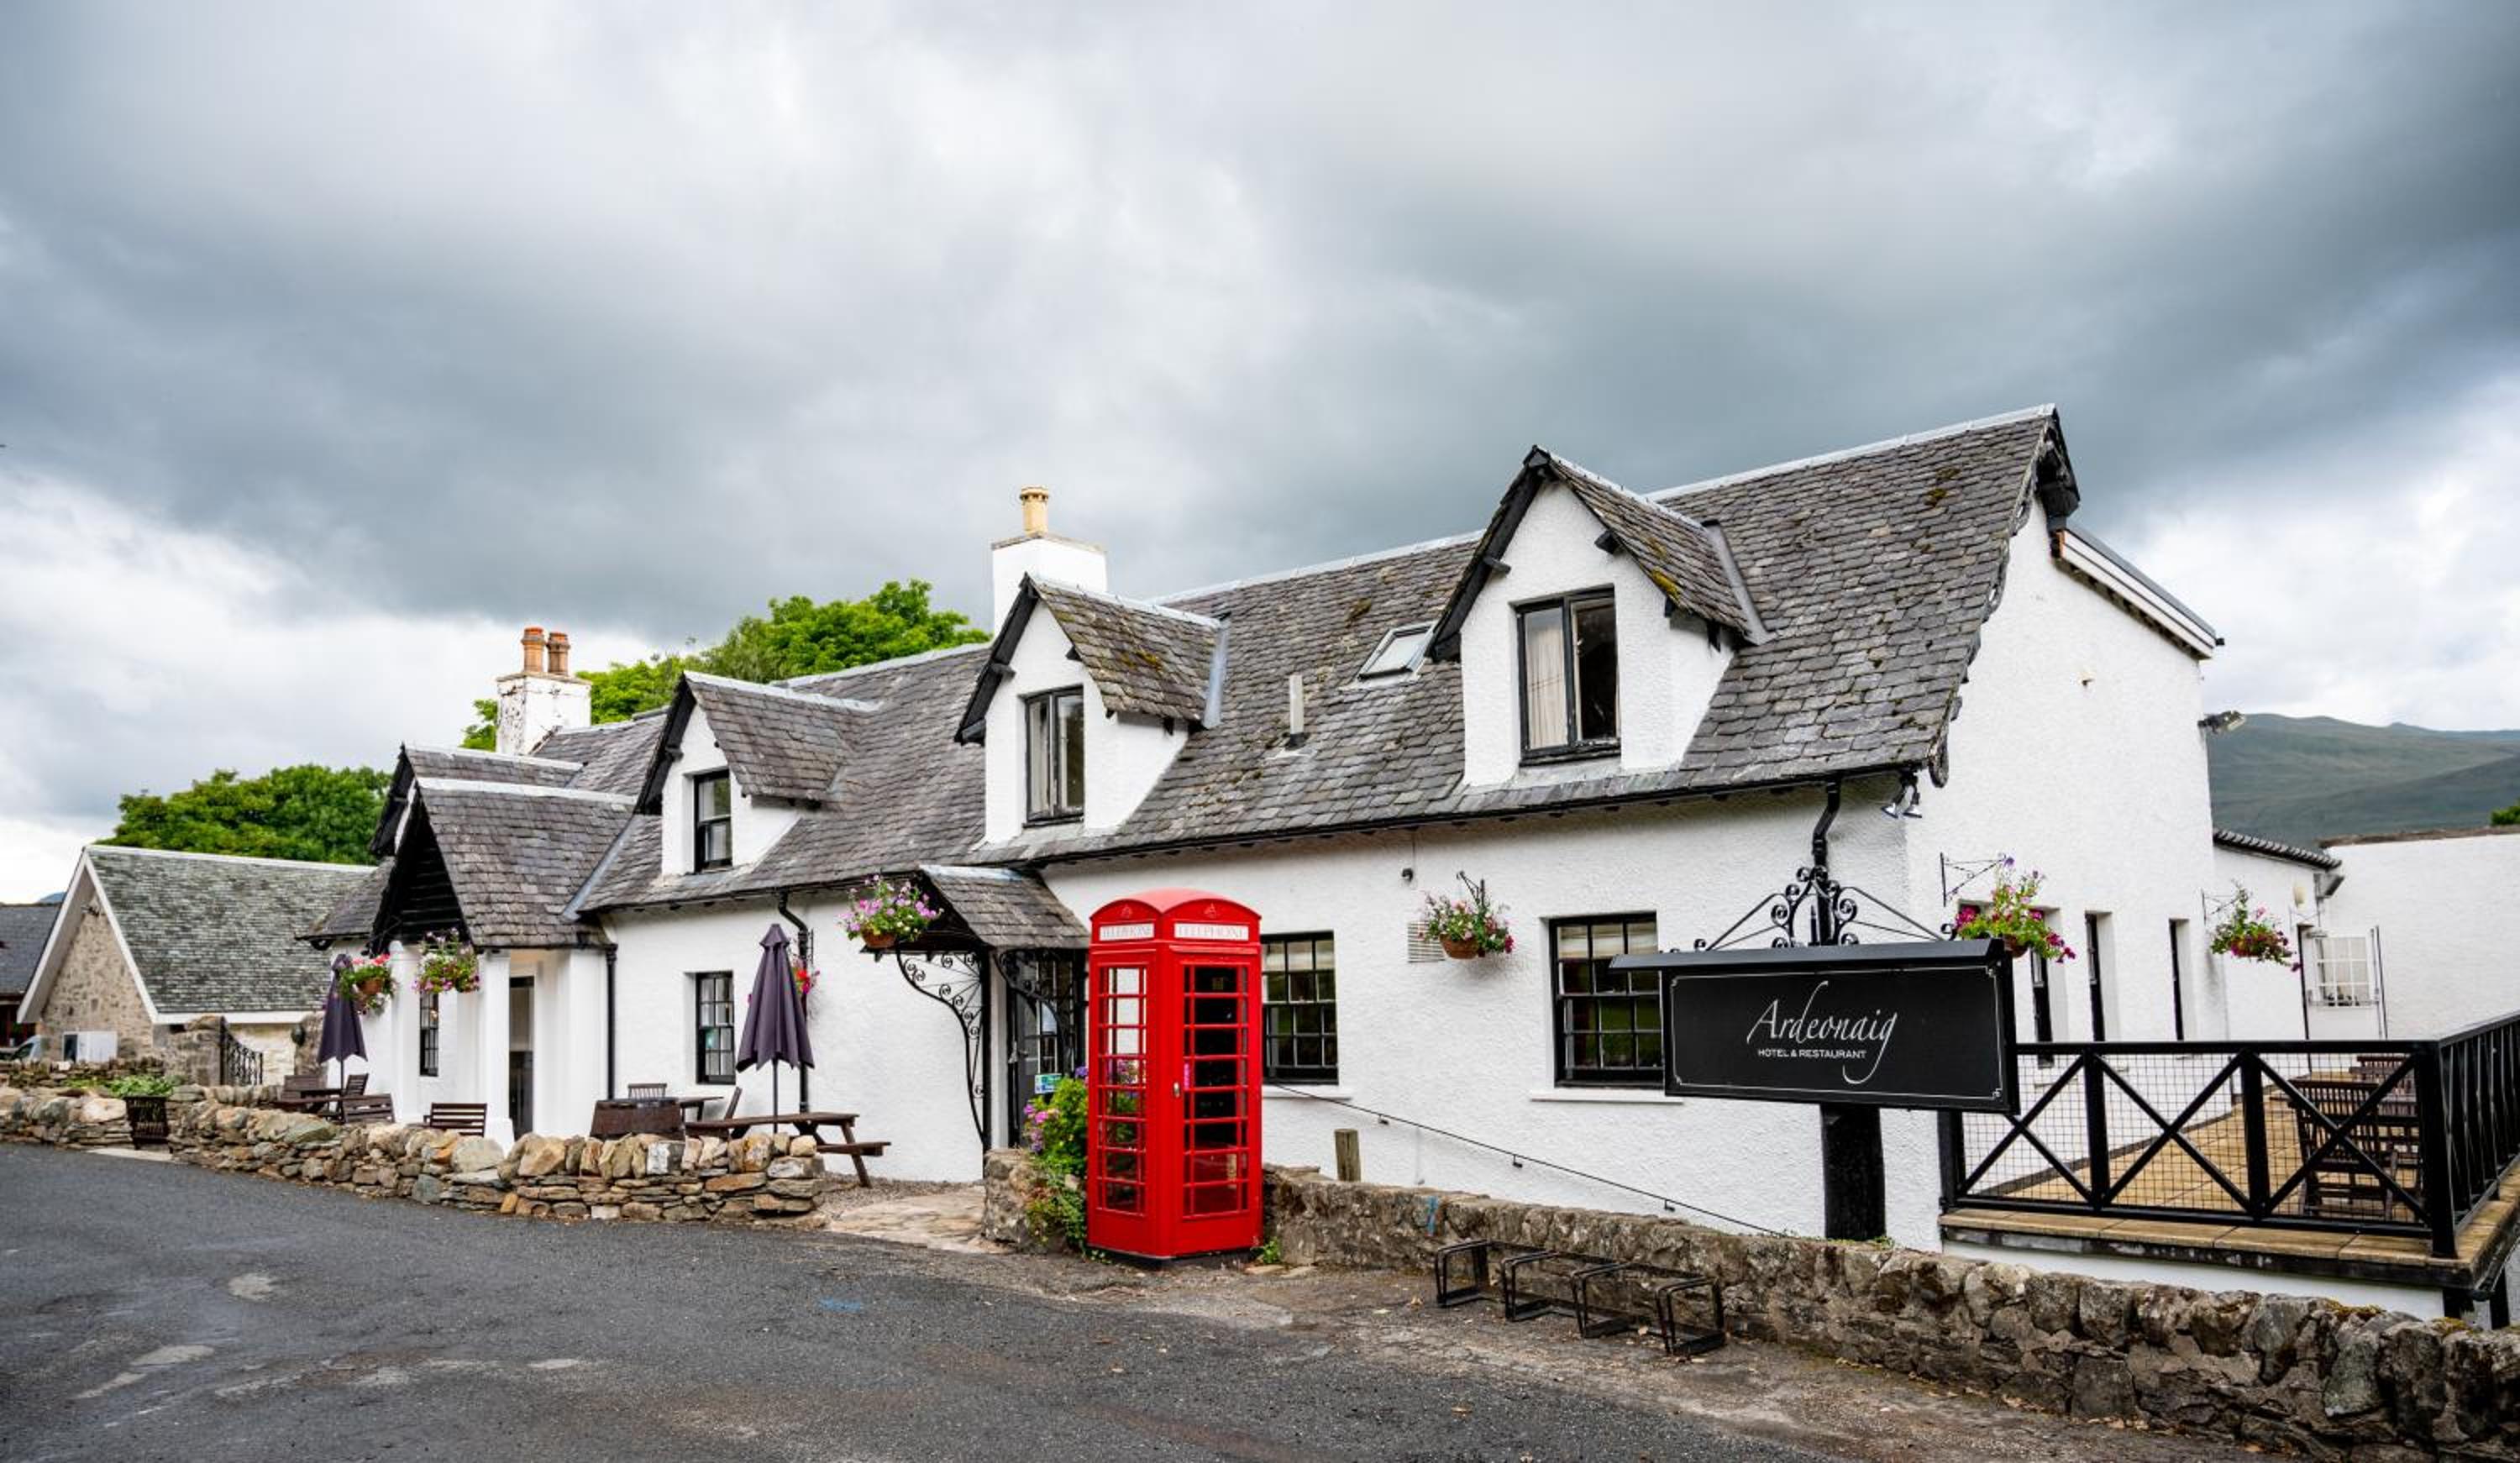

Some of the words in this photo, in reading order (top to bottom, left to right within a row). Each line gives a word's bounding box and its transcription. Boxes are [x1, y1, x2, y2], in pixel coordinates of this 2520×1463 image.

[1746, 980, 1898, 1085] Ardeonaig
[1757, 1048, 1790, 1058] HOTEL
[1791, 1049, 1798, 1058] &
[1798, 1049, 1867, 1059] RESTAURANT
